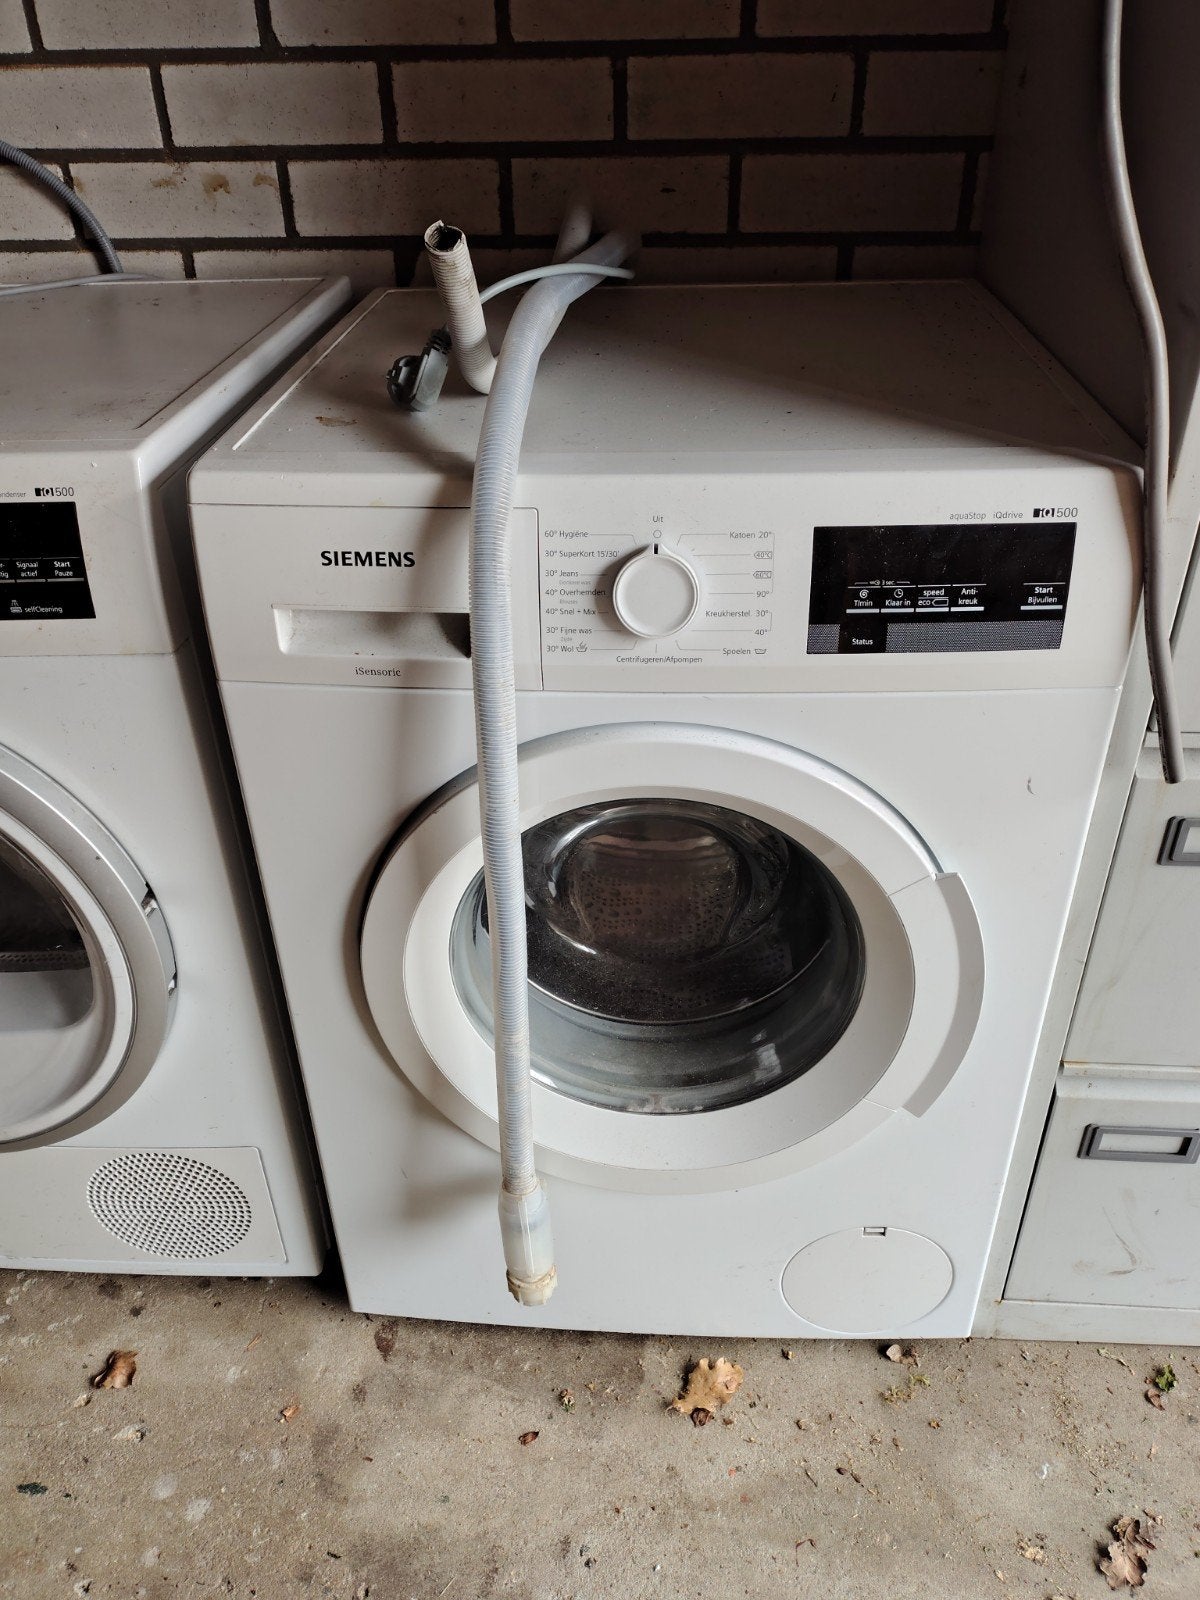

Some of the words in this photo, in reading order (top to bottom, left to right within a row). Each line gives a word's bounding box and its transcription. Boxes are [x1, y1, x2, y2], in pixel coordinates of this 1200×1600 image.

[652, 515, 663, 523] Uit
[949, 511, 986, 521] aquaStop
[993, 511, 1024, 519] iQdrive
[729, 531, 756, 539] Katoen
[559, 550, 595, 558] SuperKort
[320, 550, 416, 568] SIEMENS
[15, 561, 39, 570] Signaal
[53, 560, 71, 568] Start
[560, 588, 606, 596] Overhemden
[923, 588, 945, 597] speed
[961, 587, 979, 595] Anti-
[1034, 586, 1053, 594] Start
[904, 598, 911, 606] in
[958, 597, 978, 605] kreuk
[1027, 596, 1058, 605] Bijvullen
[24, 605, 63, 614] selfCleaning
[560, 626, 577, 635] Fijne
[852, 638, 873, 646] Status
[722, 648, 751, 656] Spoelen
[355, 666, 401, 677] iSensoric
